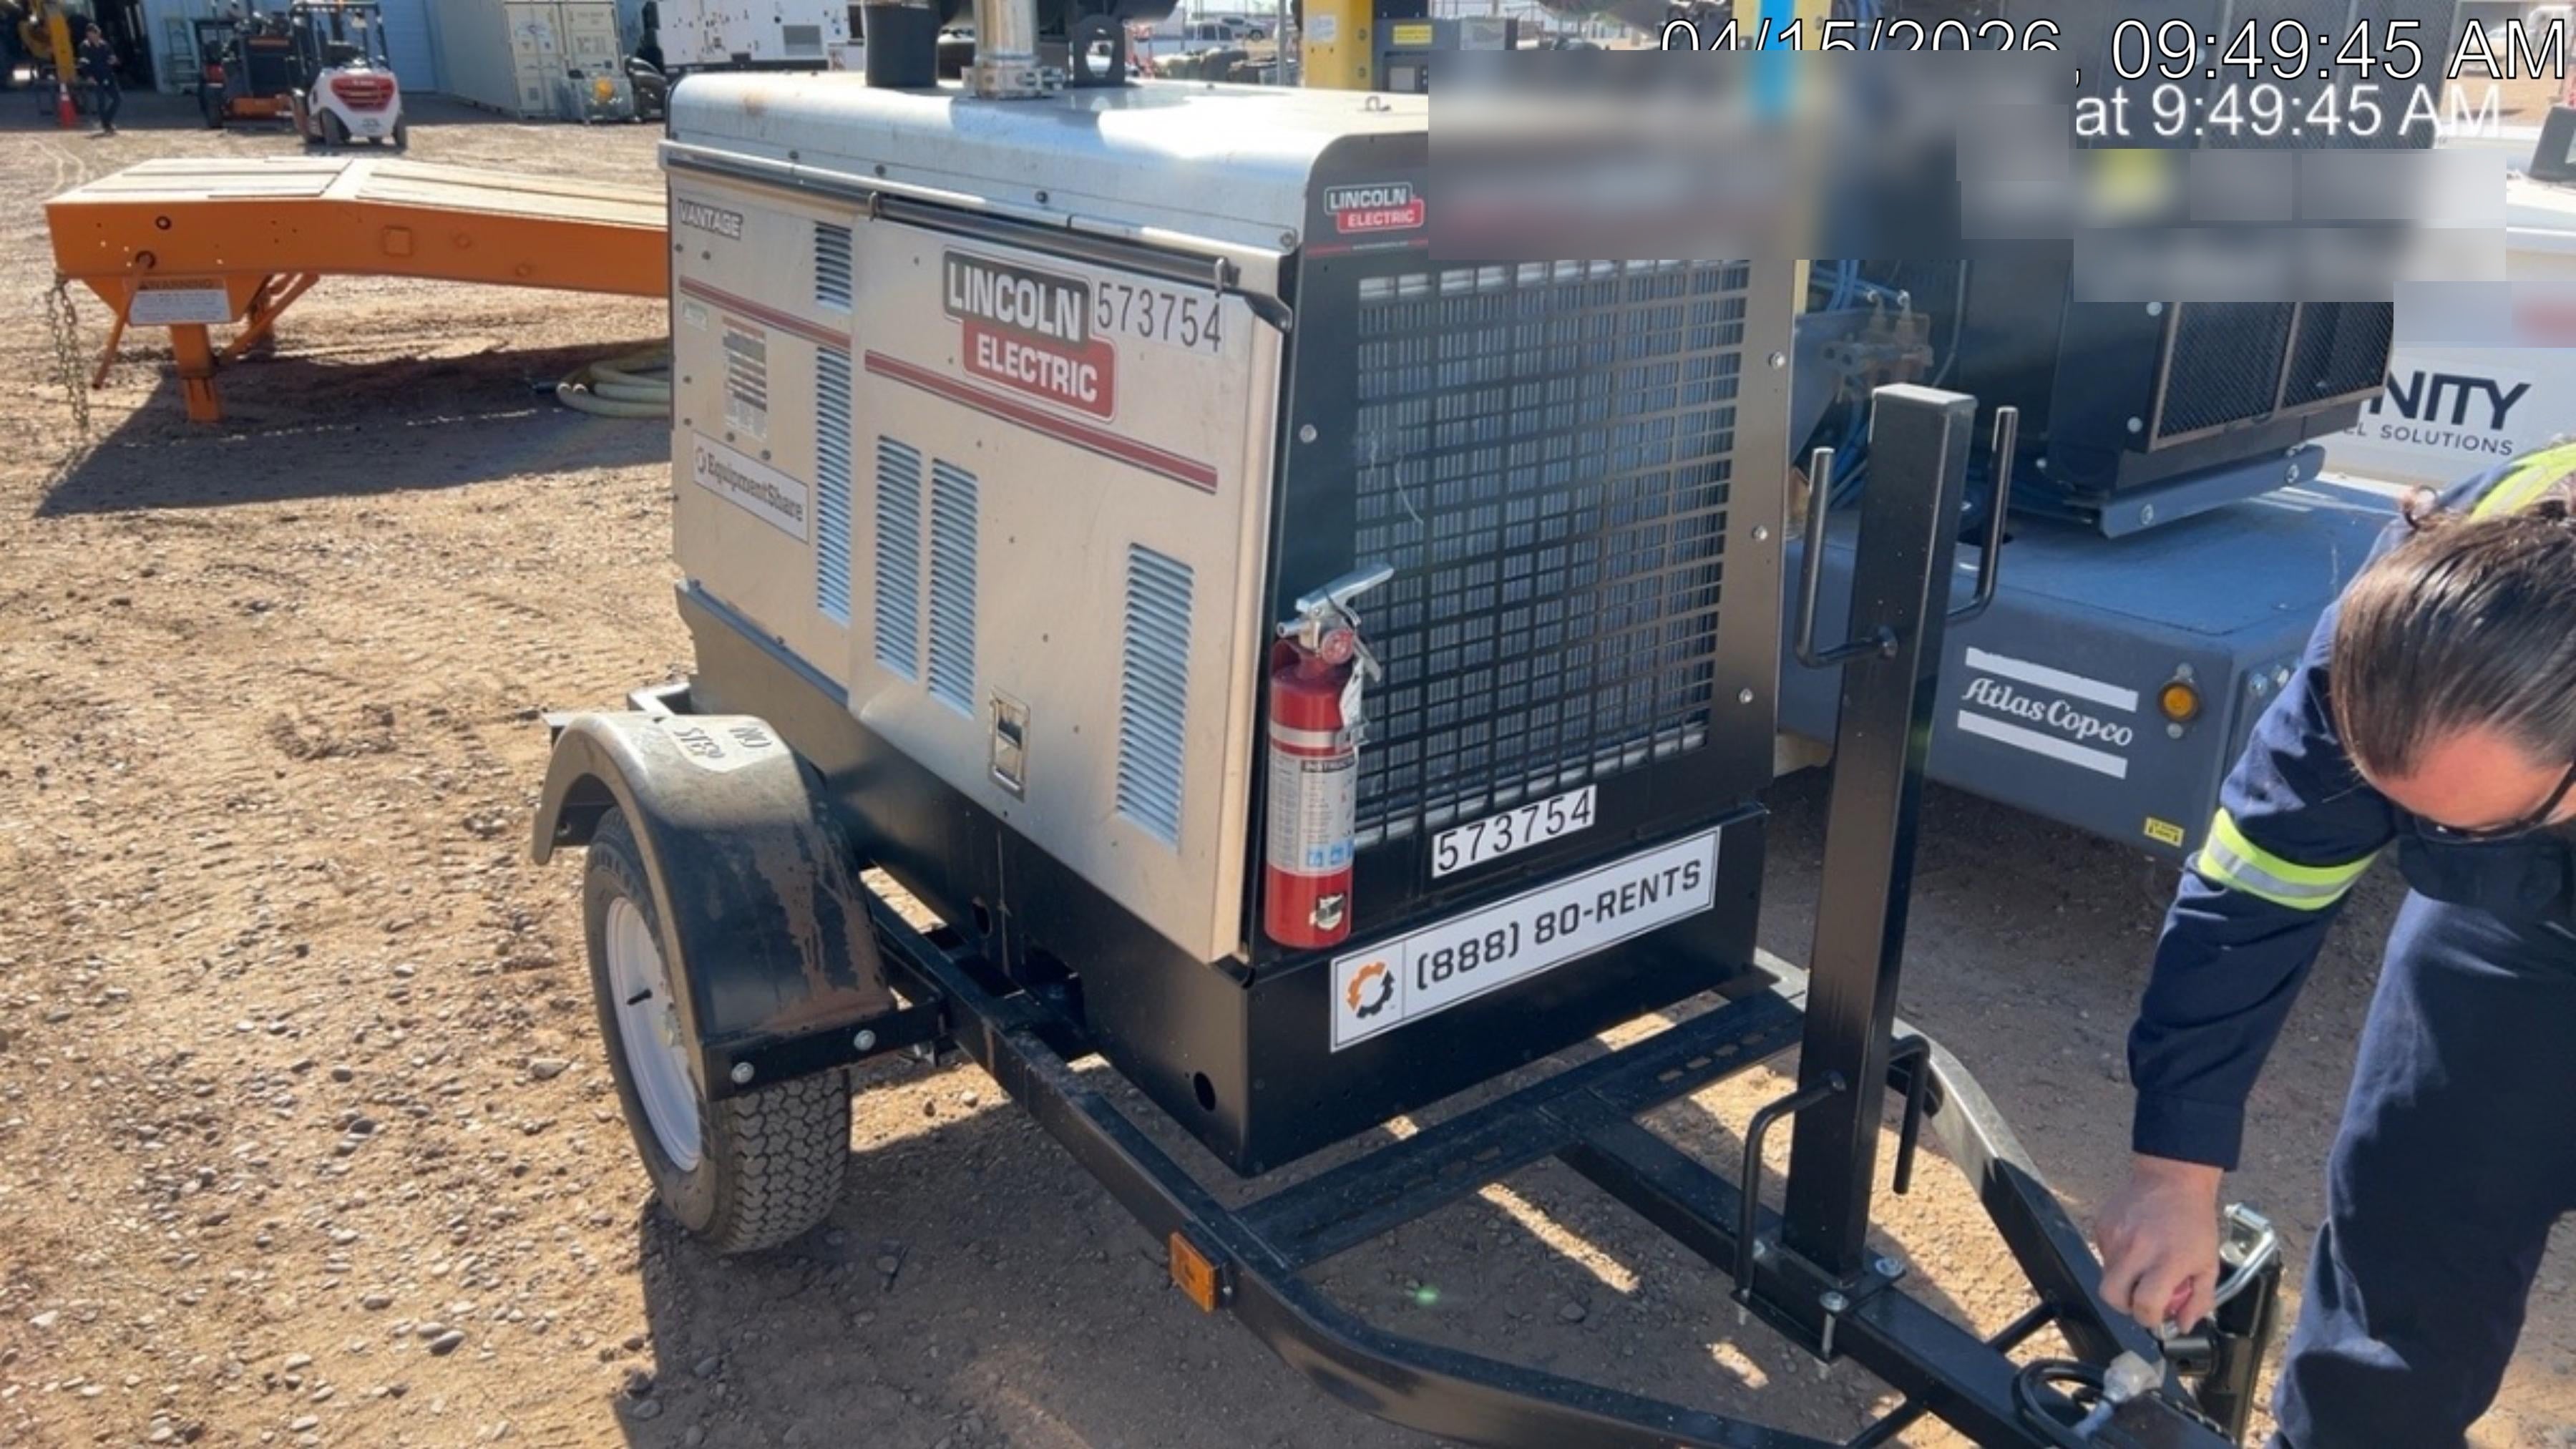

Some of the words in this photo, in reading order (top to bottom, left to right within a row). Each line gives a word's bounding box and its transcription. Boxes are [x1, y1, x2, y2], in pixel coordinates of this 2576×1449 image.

[677, 197, 743, 240] VANTAGE
[1329, 187, 1407, 210] LINCOLN
[1347, 209, 1415, 228] ELECTRIC
[948, 261, 1081, 343] LINCOLN
[1097, 282, 1221, 352] 573754
[977, 333, 1098, 403] ELECTRIC
[2380, 424, 2514, 457] SOLUTIONS
[708, 452, 804, 522] EquipmentShare
[1961, 677, 2046, 721] Atlas
[2047, 698, 2133, 746] Copco
[1438, 789, 1591, 871] 573754
[1417, 922, 1518, 991] (888)
[1534, 859, 1702, 945] 80-RENTS
